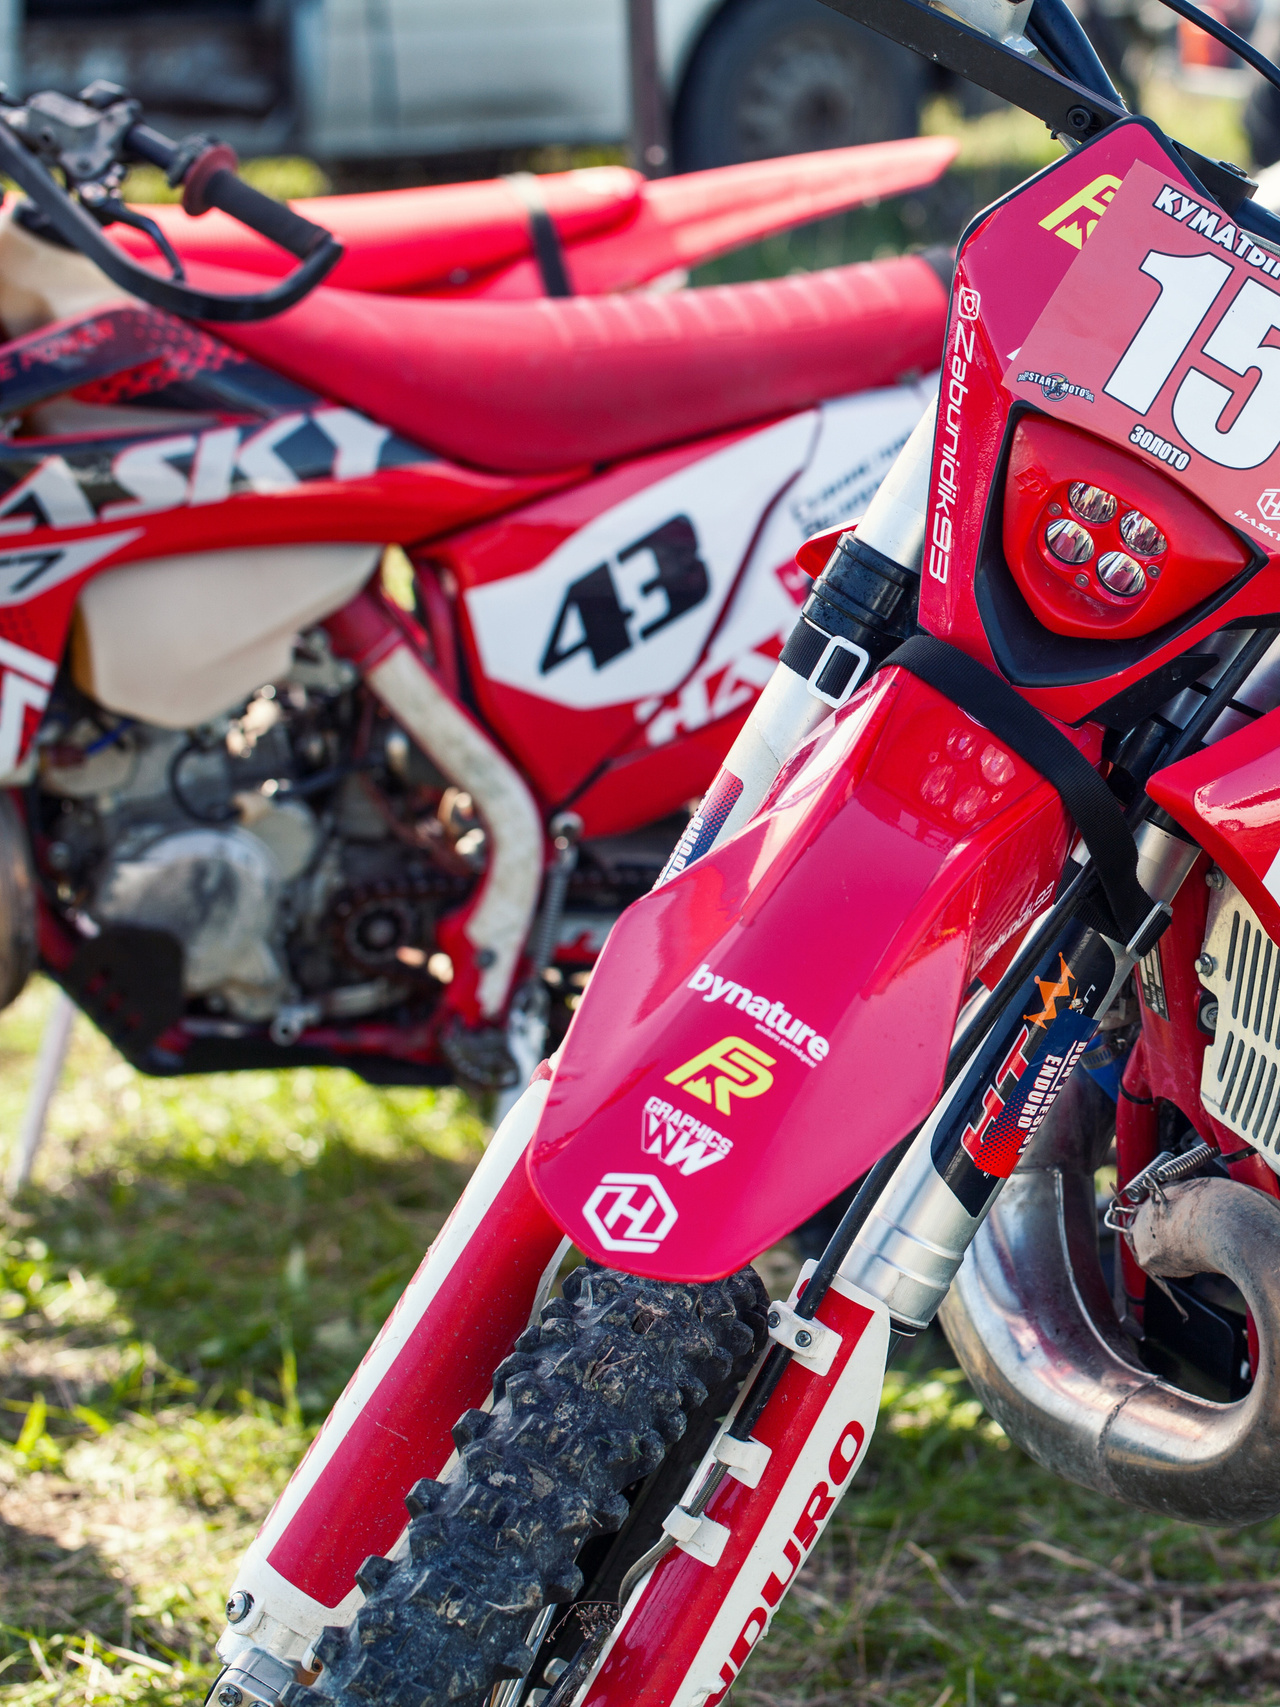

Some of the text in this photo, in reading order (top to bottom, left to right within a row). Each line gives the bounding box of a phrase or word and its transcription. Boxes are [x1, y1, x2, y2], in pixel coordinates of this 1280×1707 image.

[1028, 372, 1058, 388] START
[1060, 382, 1087, 398] MOTO
[928, 321, 976, 584] Zabunidik93
[1129, 424, 1191, 471] ЗОЛОТО
[540, 513, 711, 678] 43
[687, 964, 830, 1061] bynature
[644, 1095, 734, 1156] GRAPHICS
[1017, 1054, 1064, 1129] ENDURO
